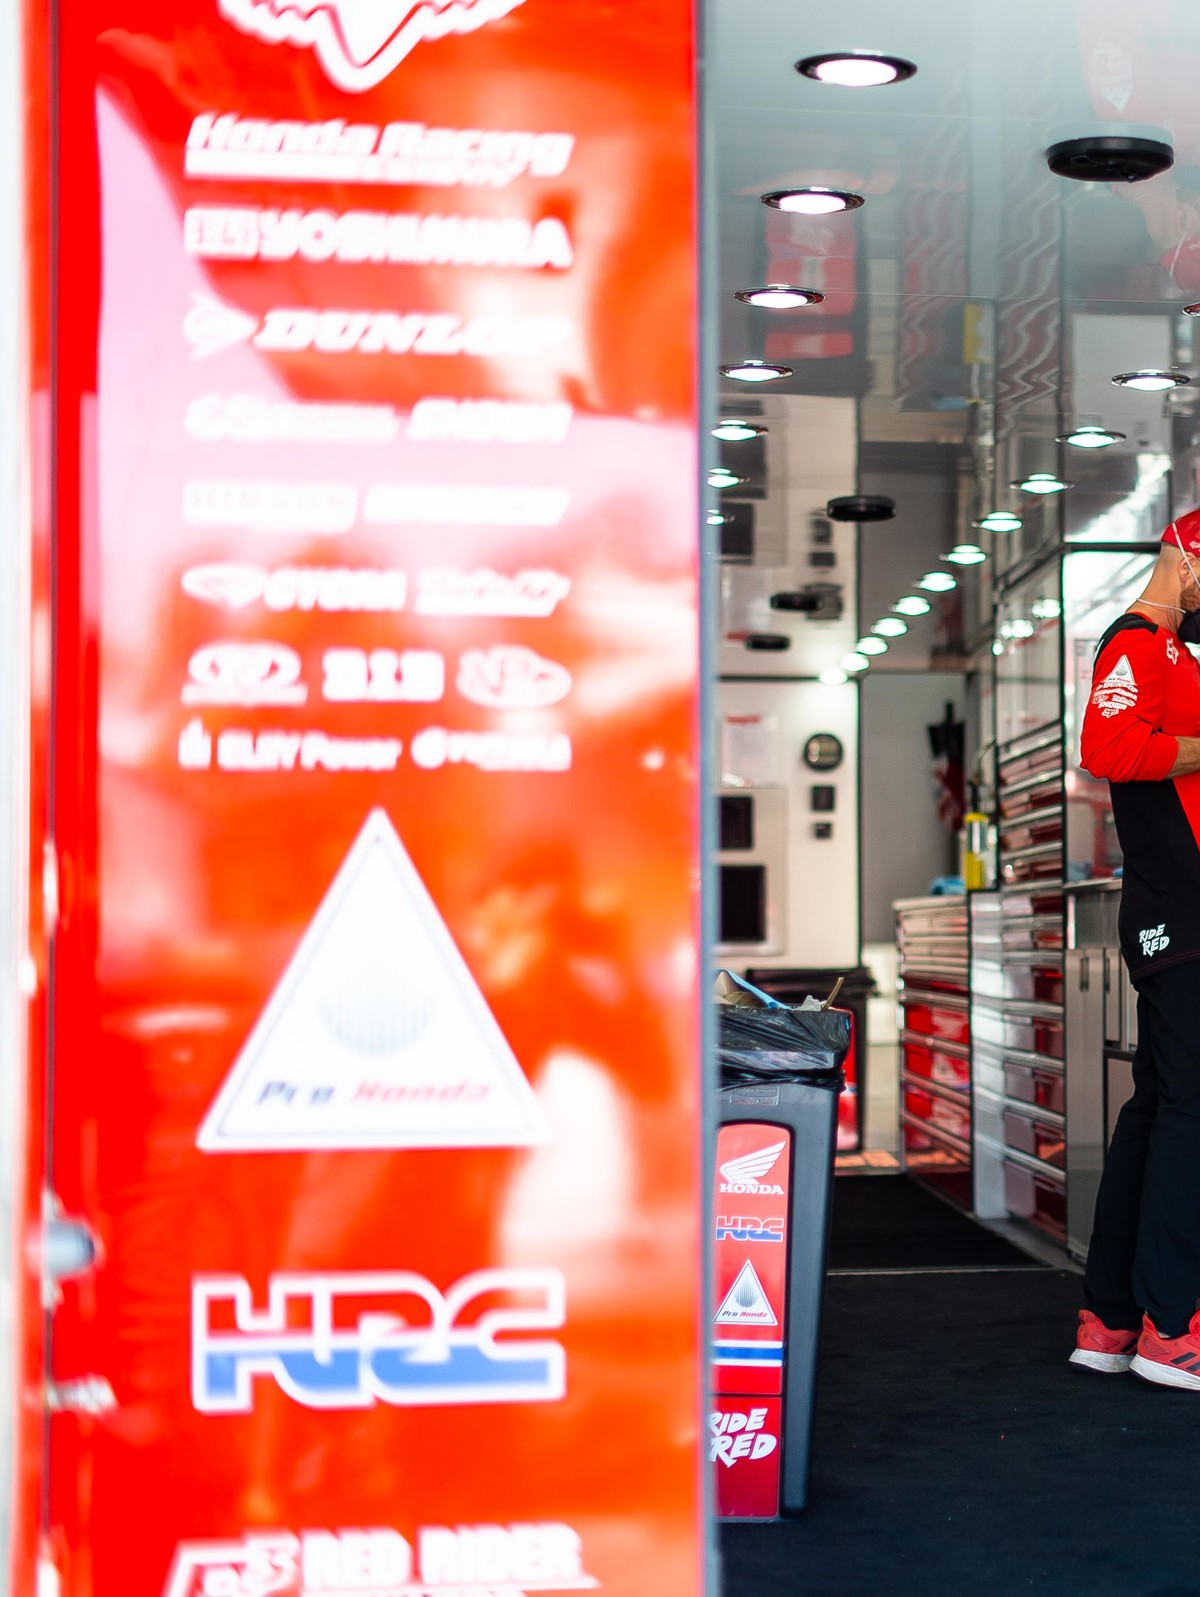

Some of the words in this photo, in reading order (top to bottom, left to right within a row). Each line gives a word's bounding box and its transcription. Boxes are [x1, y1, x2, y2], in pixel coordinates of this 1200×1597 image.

[186, 114, 380, 156] Honda
[377, 121, 575, 176] Racing
[1139, 923, 1166, 943] RIDE
[1142, 936, 1170, 957] RED
[257, 1081, 335, 1104] Pro
[352, 1080, 490, 1104] Honda
[719, 1183, 785, 1195] HONDA
[716, 1216, 784, 1242] HRC
[740, 1310, 768, 1318] Honda
[191, 1268, 566, 1412] HRC
[708, 1408, 768, 1436] RIDE
[708, 1432, 777, 1468] RED
[418, 1520, 583, 1583] RIDER
